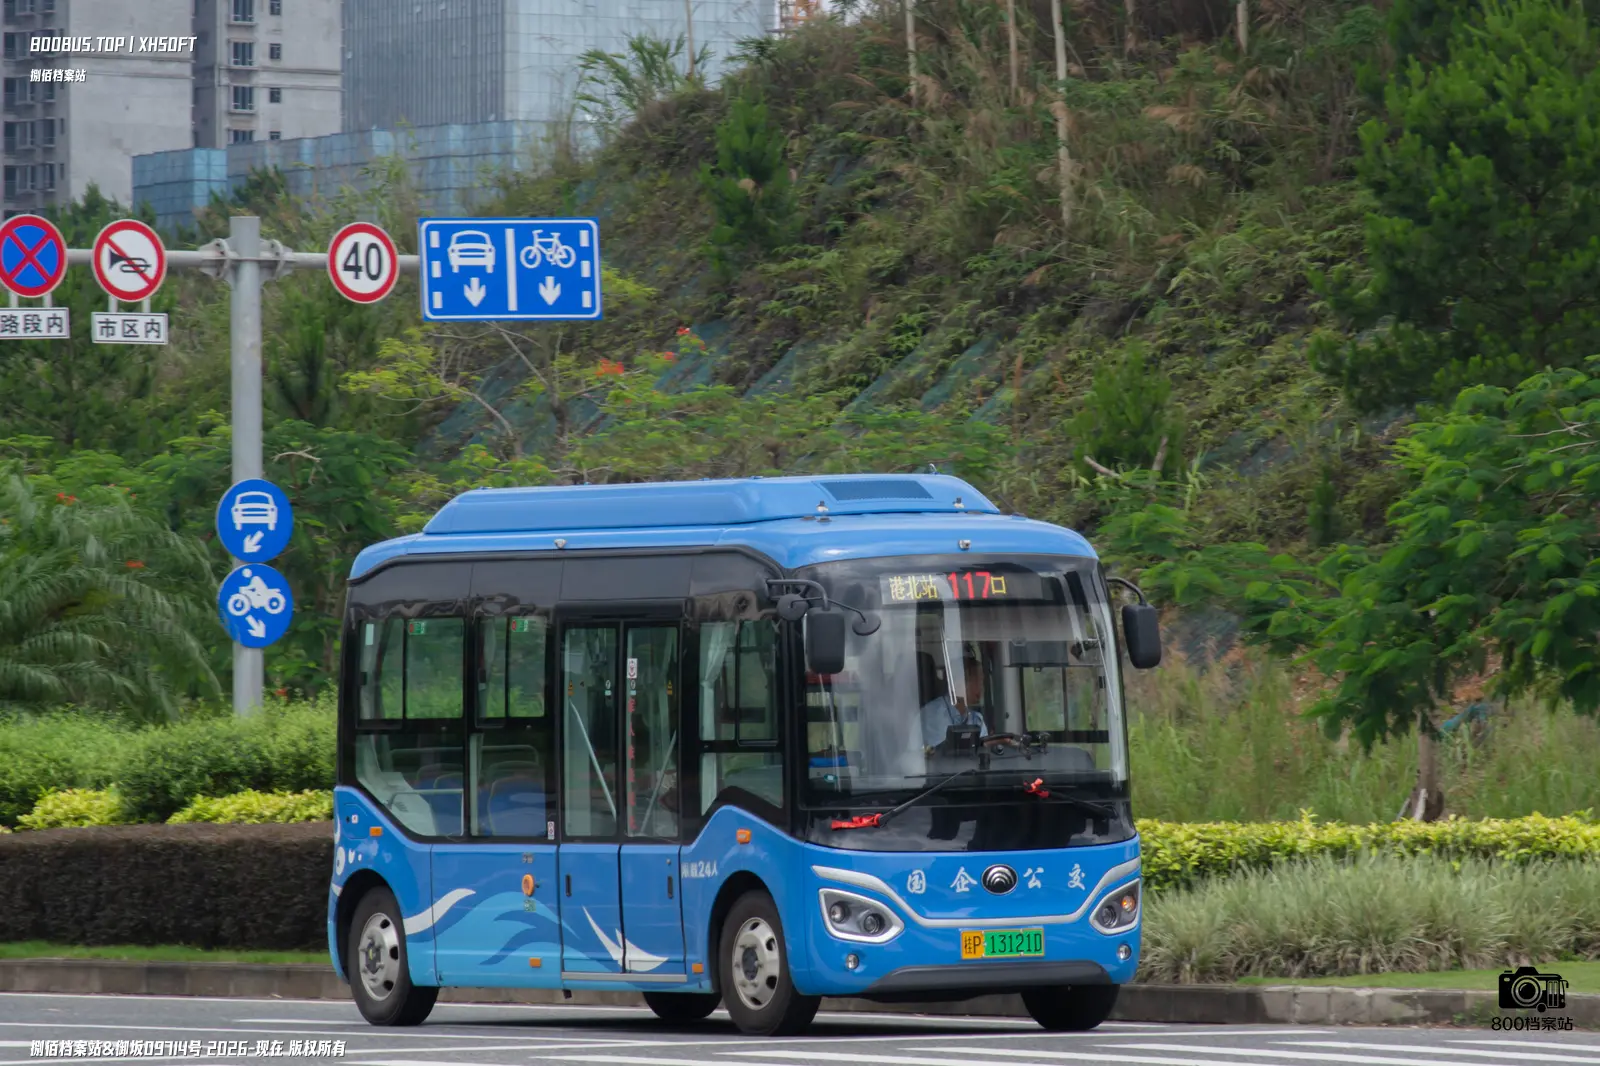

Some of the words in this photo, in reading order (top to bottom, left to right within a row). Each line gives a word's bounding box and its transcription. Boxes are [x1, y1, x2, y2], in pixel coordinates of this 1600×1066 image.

[342, 241, 383, 281] 40
[0, 313, 64, 334] 路段内
[97, 318, 162, 339] 市区内
[888, 574, 939, 601] 港北站
[947, 571, 991, 599] 117
[989, 932, 1043, 954] 13121D
